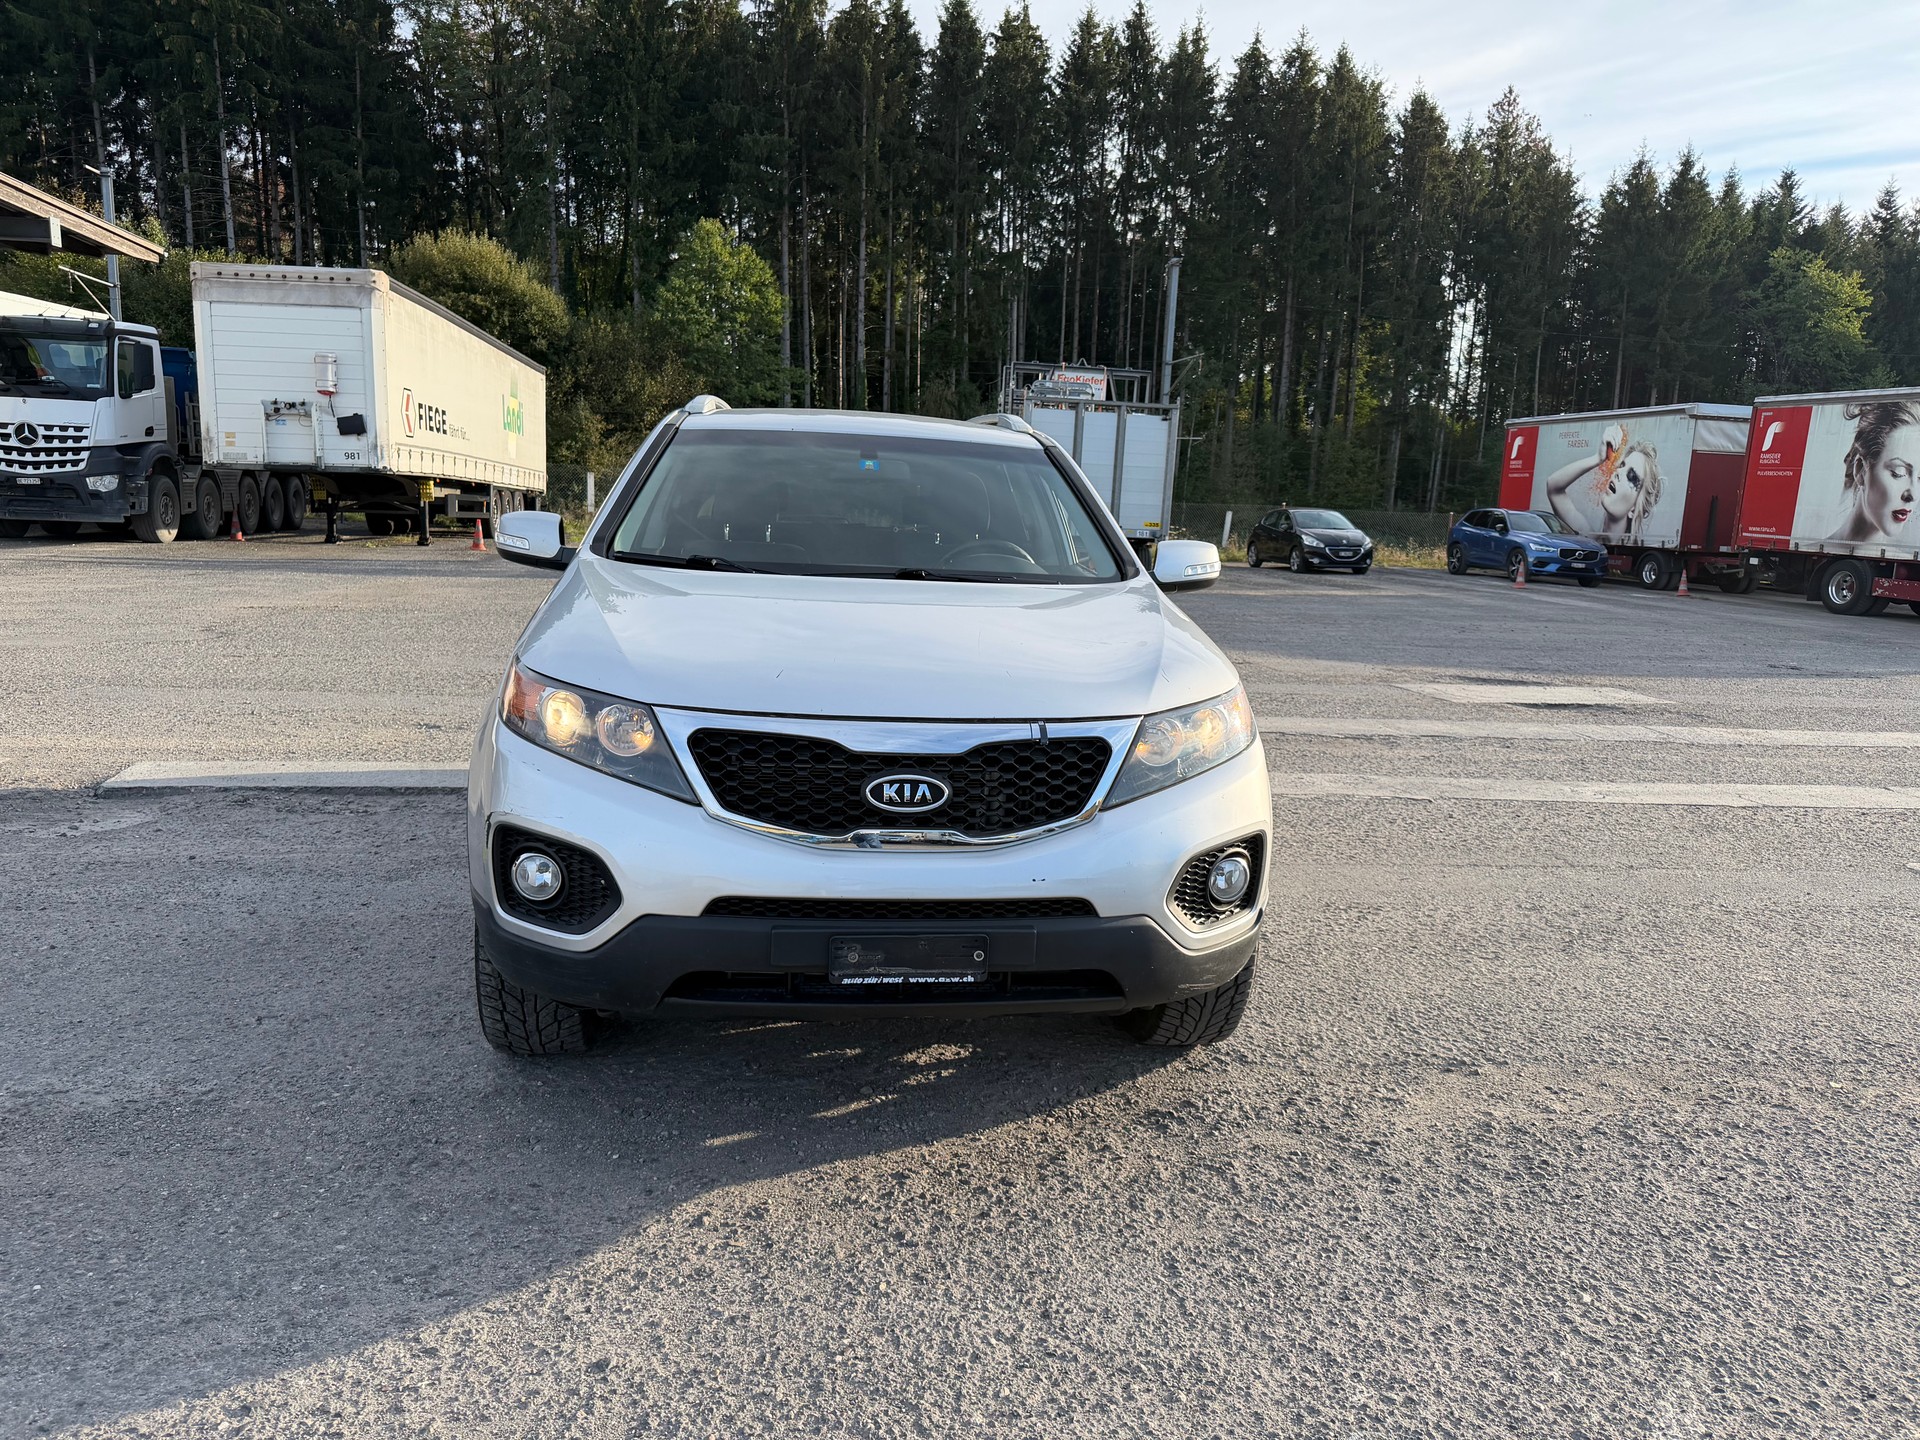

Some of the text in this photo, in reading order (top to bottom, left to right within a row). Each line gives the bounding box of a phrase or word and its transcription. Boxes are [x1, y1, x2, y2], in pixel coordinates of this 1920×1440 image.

[417, 402, 448, 435] FIEGE
[1559, 431, 1580, 439] PERFEKTE
[1567, 440, 1589, 448] FARBEN
[344, 452, 360, 460] 981
[882, 783, 933, 803] KIA
[841, 976, 863, 984] auto
[882, 976, 905, 984] west
